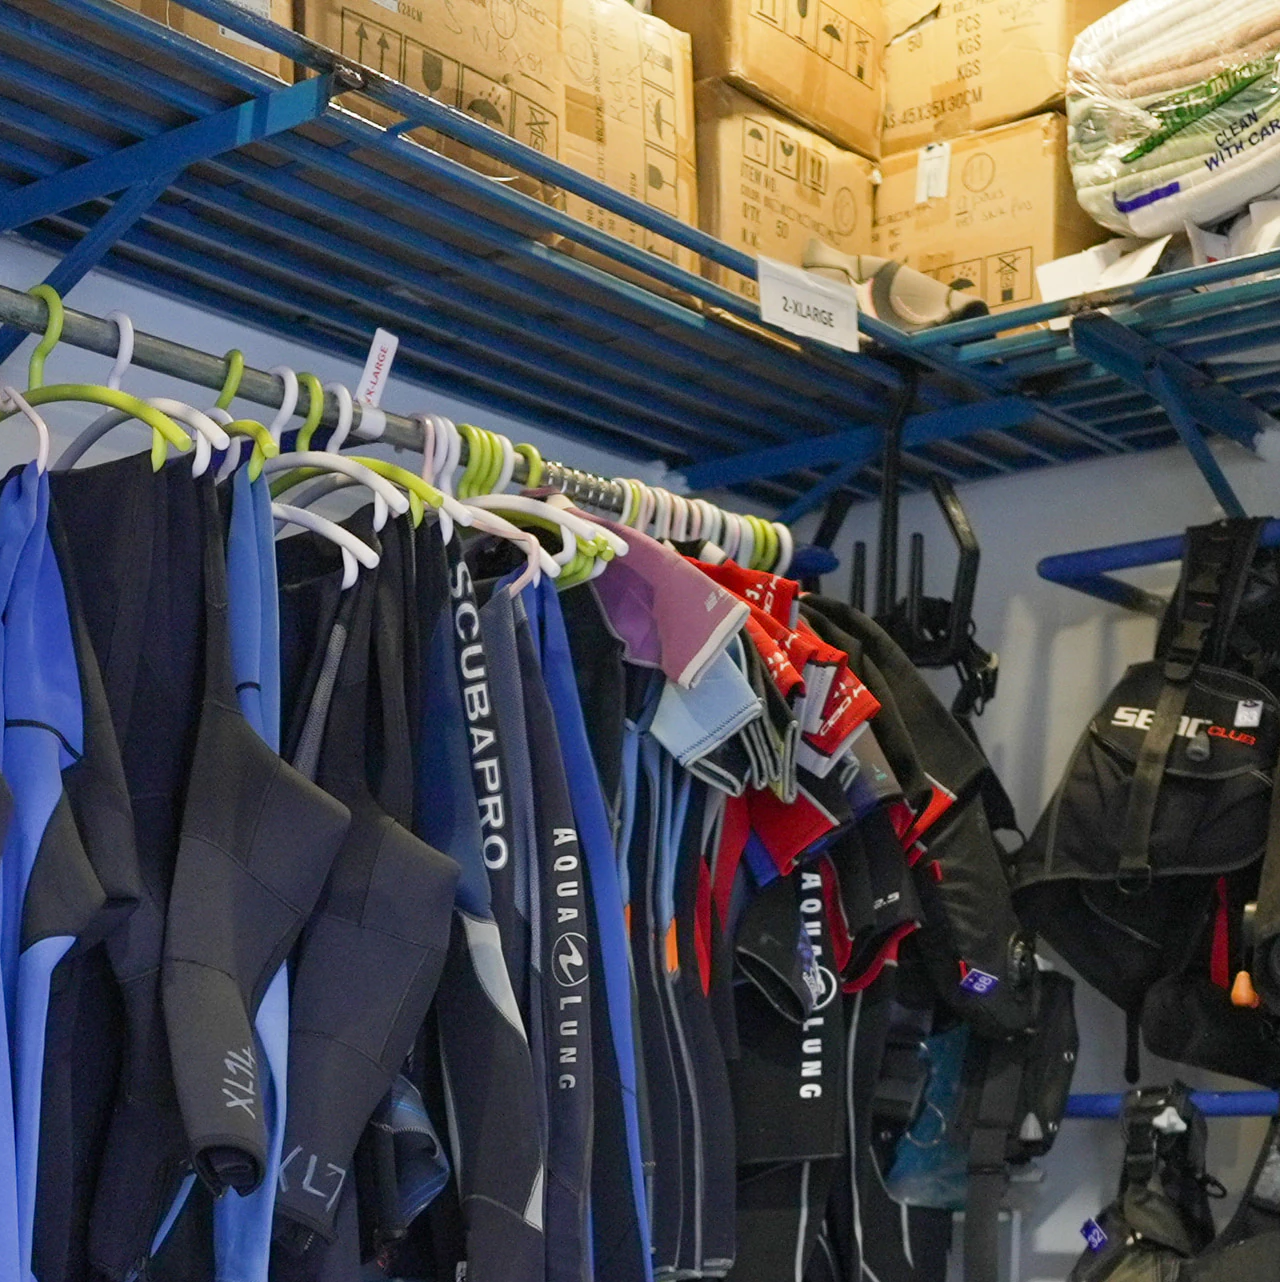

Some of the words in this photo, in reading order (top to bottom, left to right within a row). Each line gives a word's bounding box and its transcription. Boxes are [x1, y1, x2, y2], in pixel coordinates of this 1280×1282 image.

[955, 13, 982, 36] PCS
[956, 34, 982, 57] KGS
[956, 59, 981, 81] KGS
[1214, 108, 1260, 147] CLEAN
[1203, 140, 1245, 172] WITH
[781, 296, 835, 328] 2-XLARGE
[448, 561, 509, 870] SCUBAPRO
[552, 827, 580, 925] AQUA
[558, 995, 582, 1091] LUNG
[799, 1017, 824, 1099] LUNG
